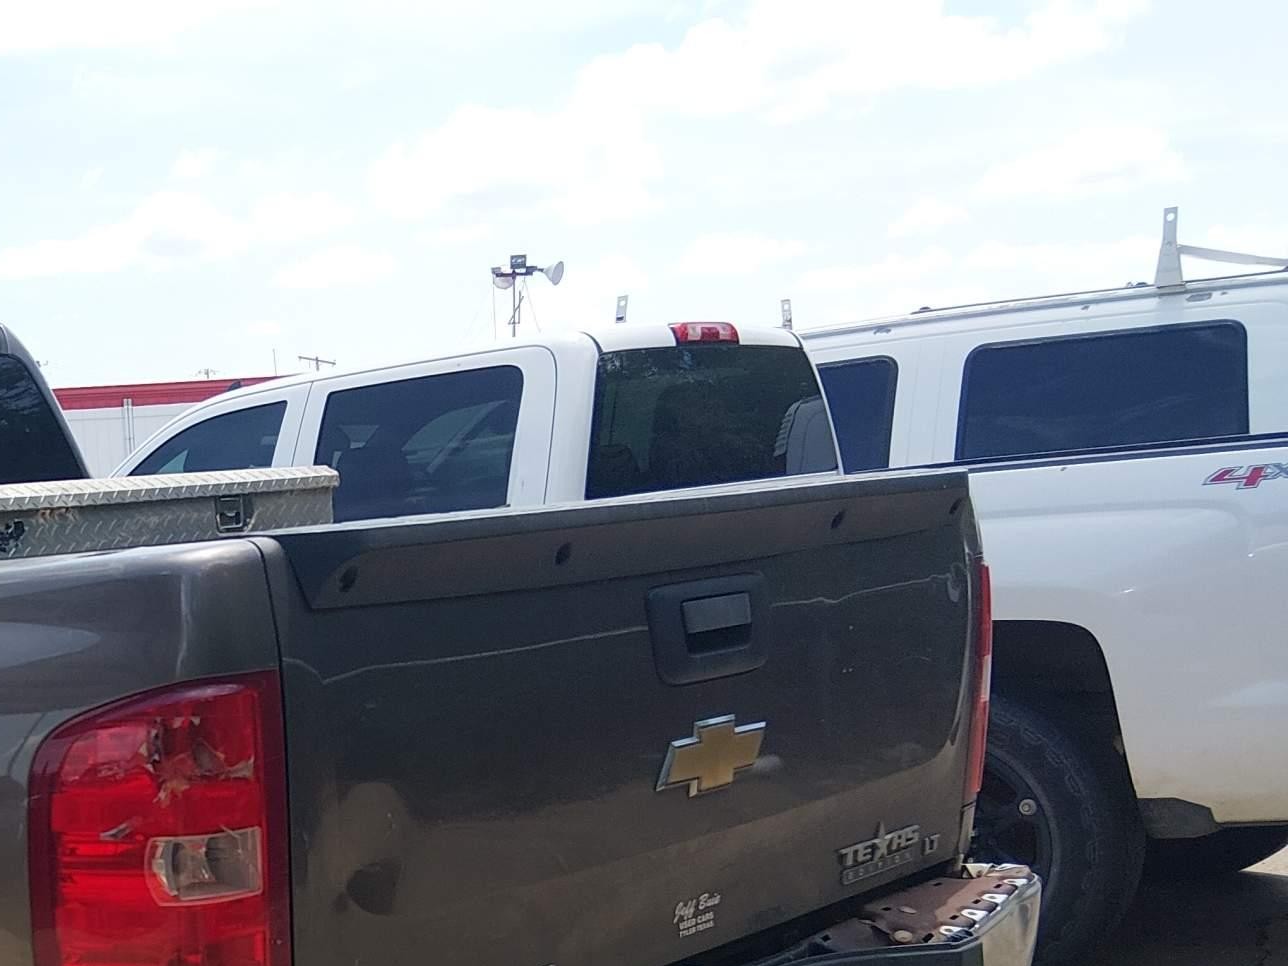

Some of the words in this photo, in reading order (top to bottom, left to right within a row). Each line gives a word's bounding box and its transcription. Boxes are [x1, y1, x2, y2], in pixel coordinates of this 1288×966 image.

[834, 820, 921, 866] TEXAS
[923, 833, 941, 856] LT
[673, 898, 697, 924] Jeff
[679, 918, 697, 930] USED
[697, 911, 715, 924] CARS
